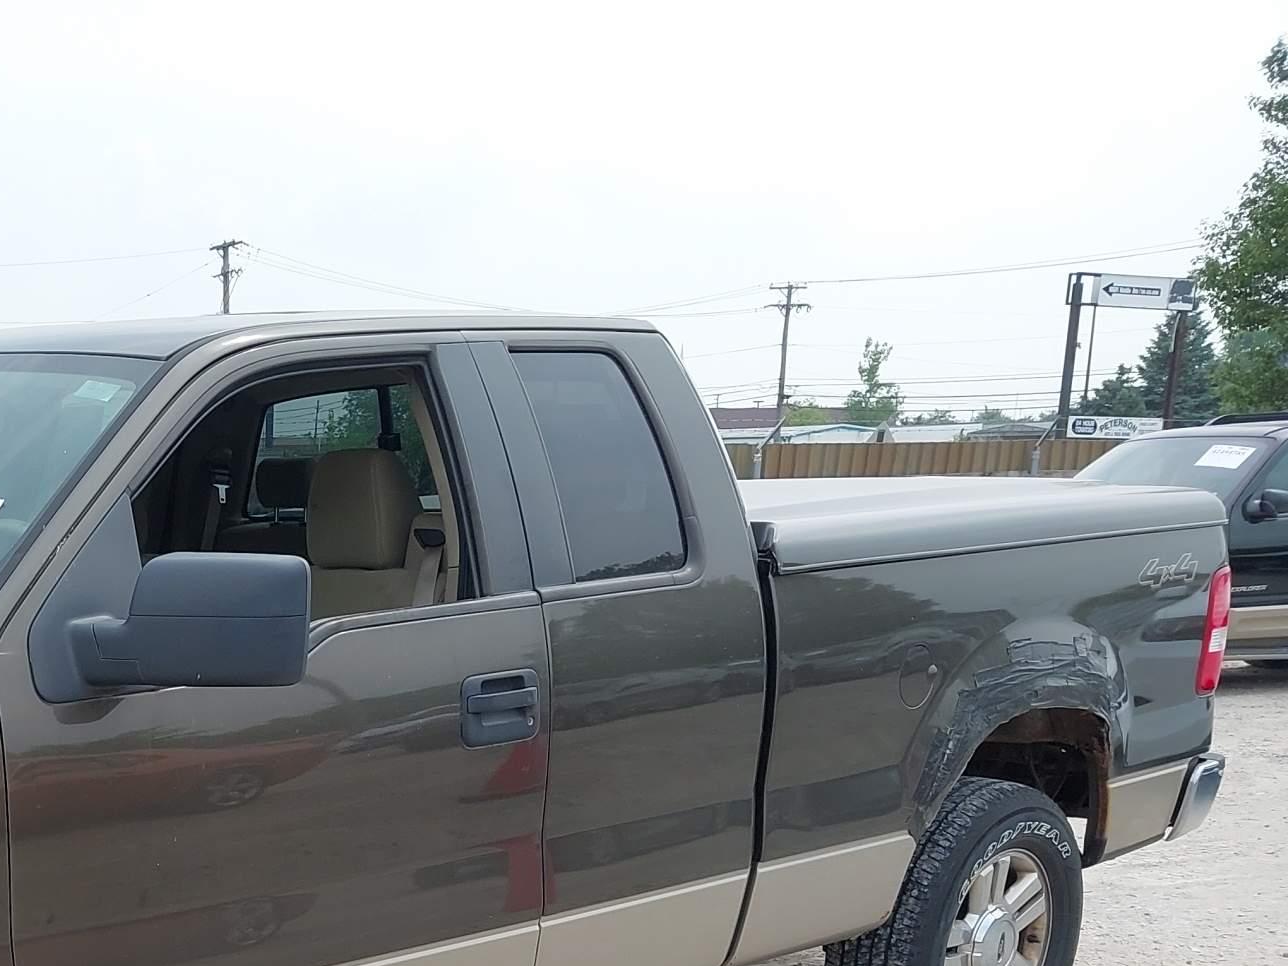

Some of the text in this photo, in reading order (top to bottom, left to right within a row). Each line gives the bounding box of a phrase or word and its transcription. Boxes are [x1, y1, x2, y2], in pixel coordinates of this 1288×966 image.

[1099, 418, 1138, 433] PETERSON
[1138, 552, 1199, 588] 4x4
[958, 821, 1073, 905] GOODYEAR
